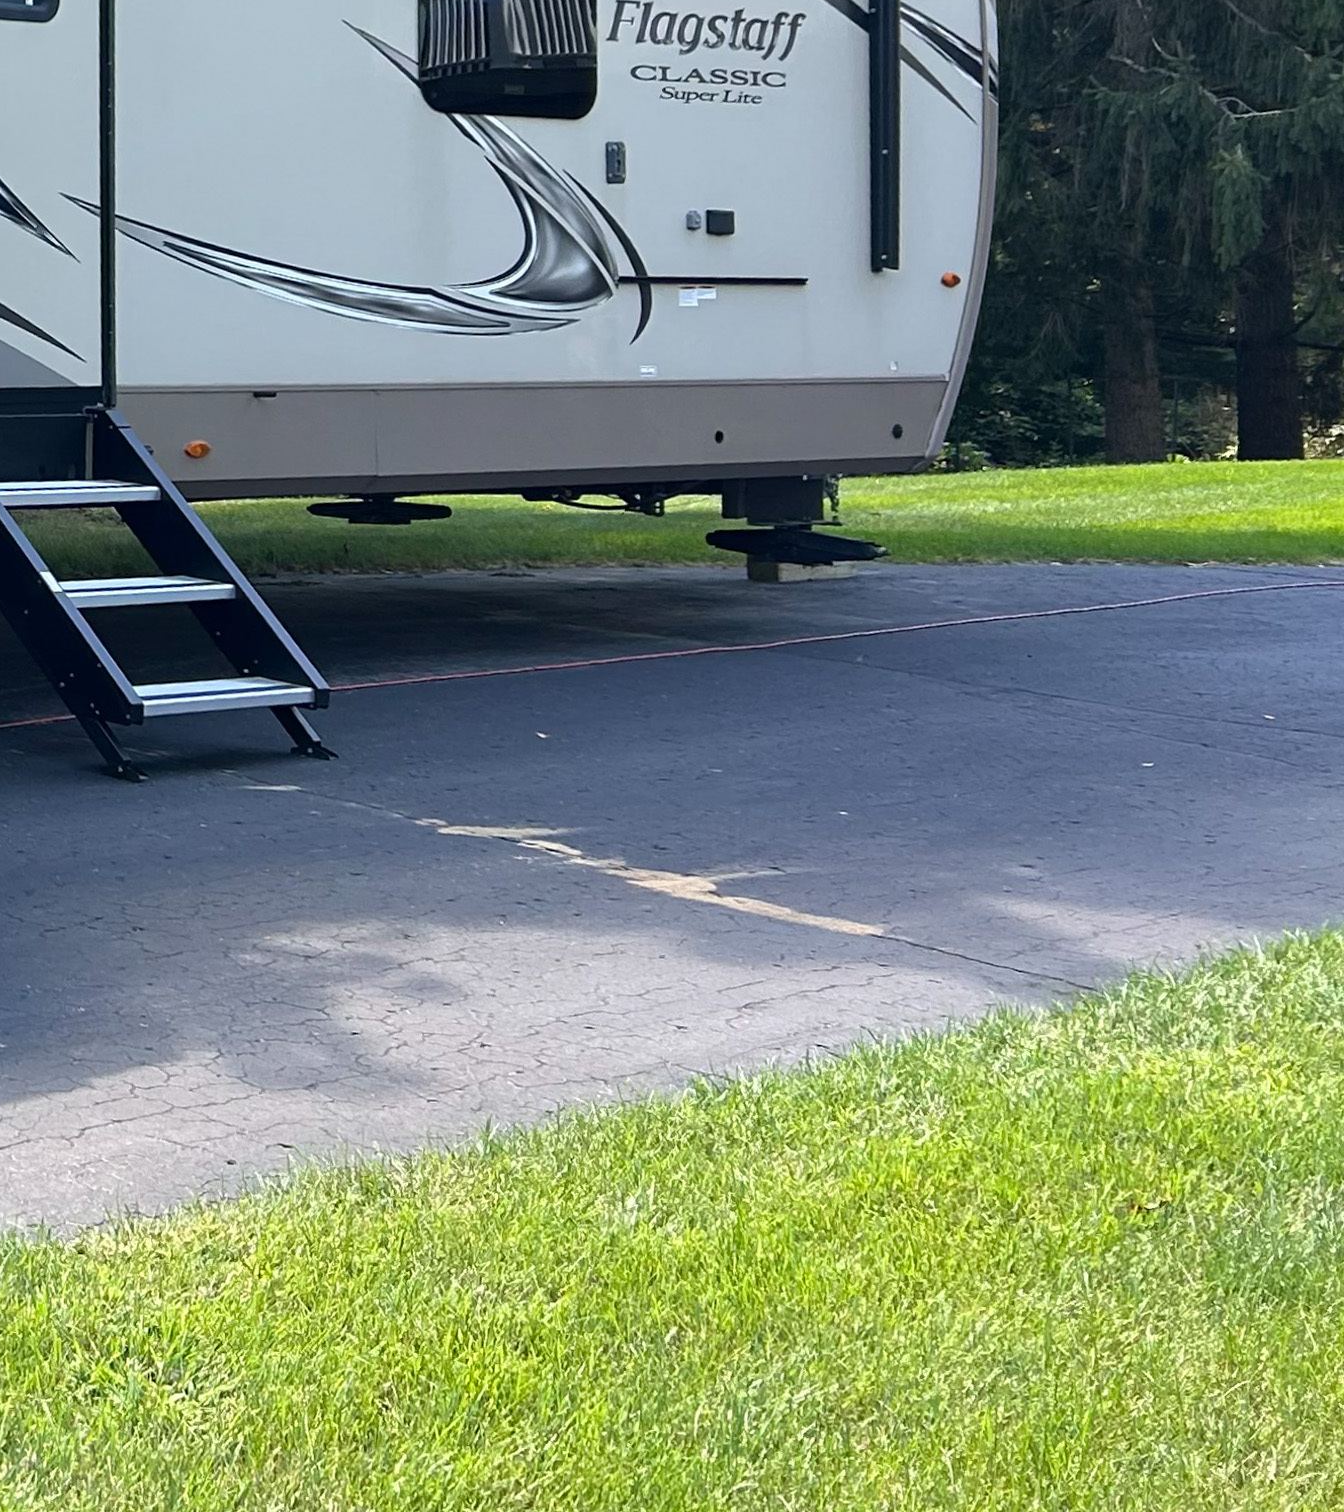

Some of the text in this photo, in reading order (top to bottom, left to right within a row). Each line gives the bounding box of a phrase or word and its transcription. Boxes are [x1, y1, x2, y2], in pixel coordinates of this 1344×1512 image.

[606, 0, 807, 61] Flagstaff
[630, 65, 787, 88] CLASSIC
[659, 86, 763, 104] Super Lite
